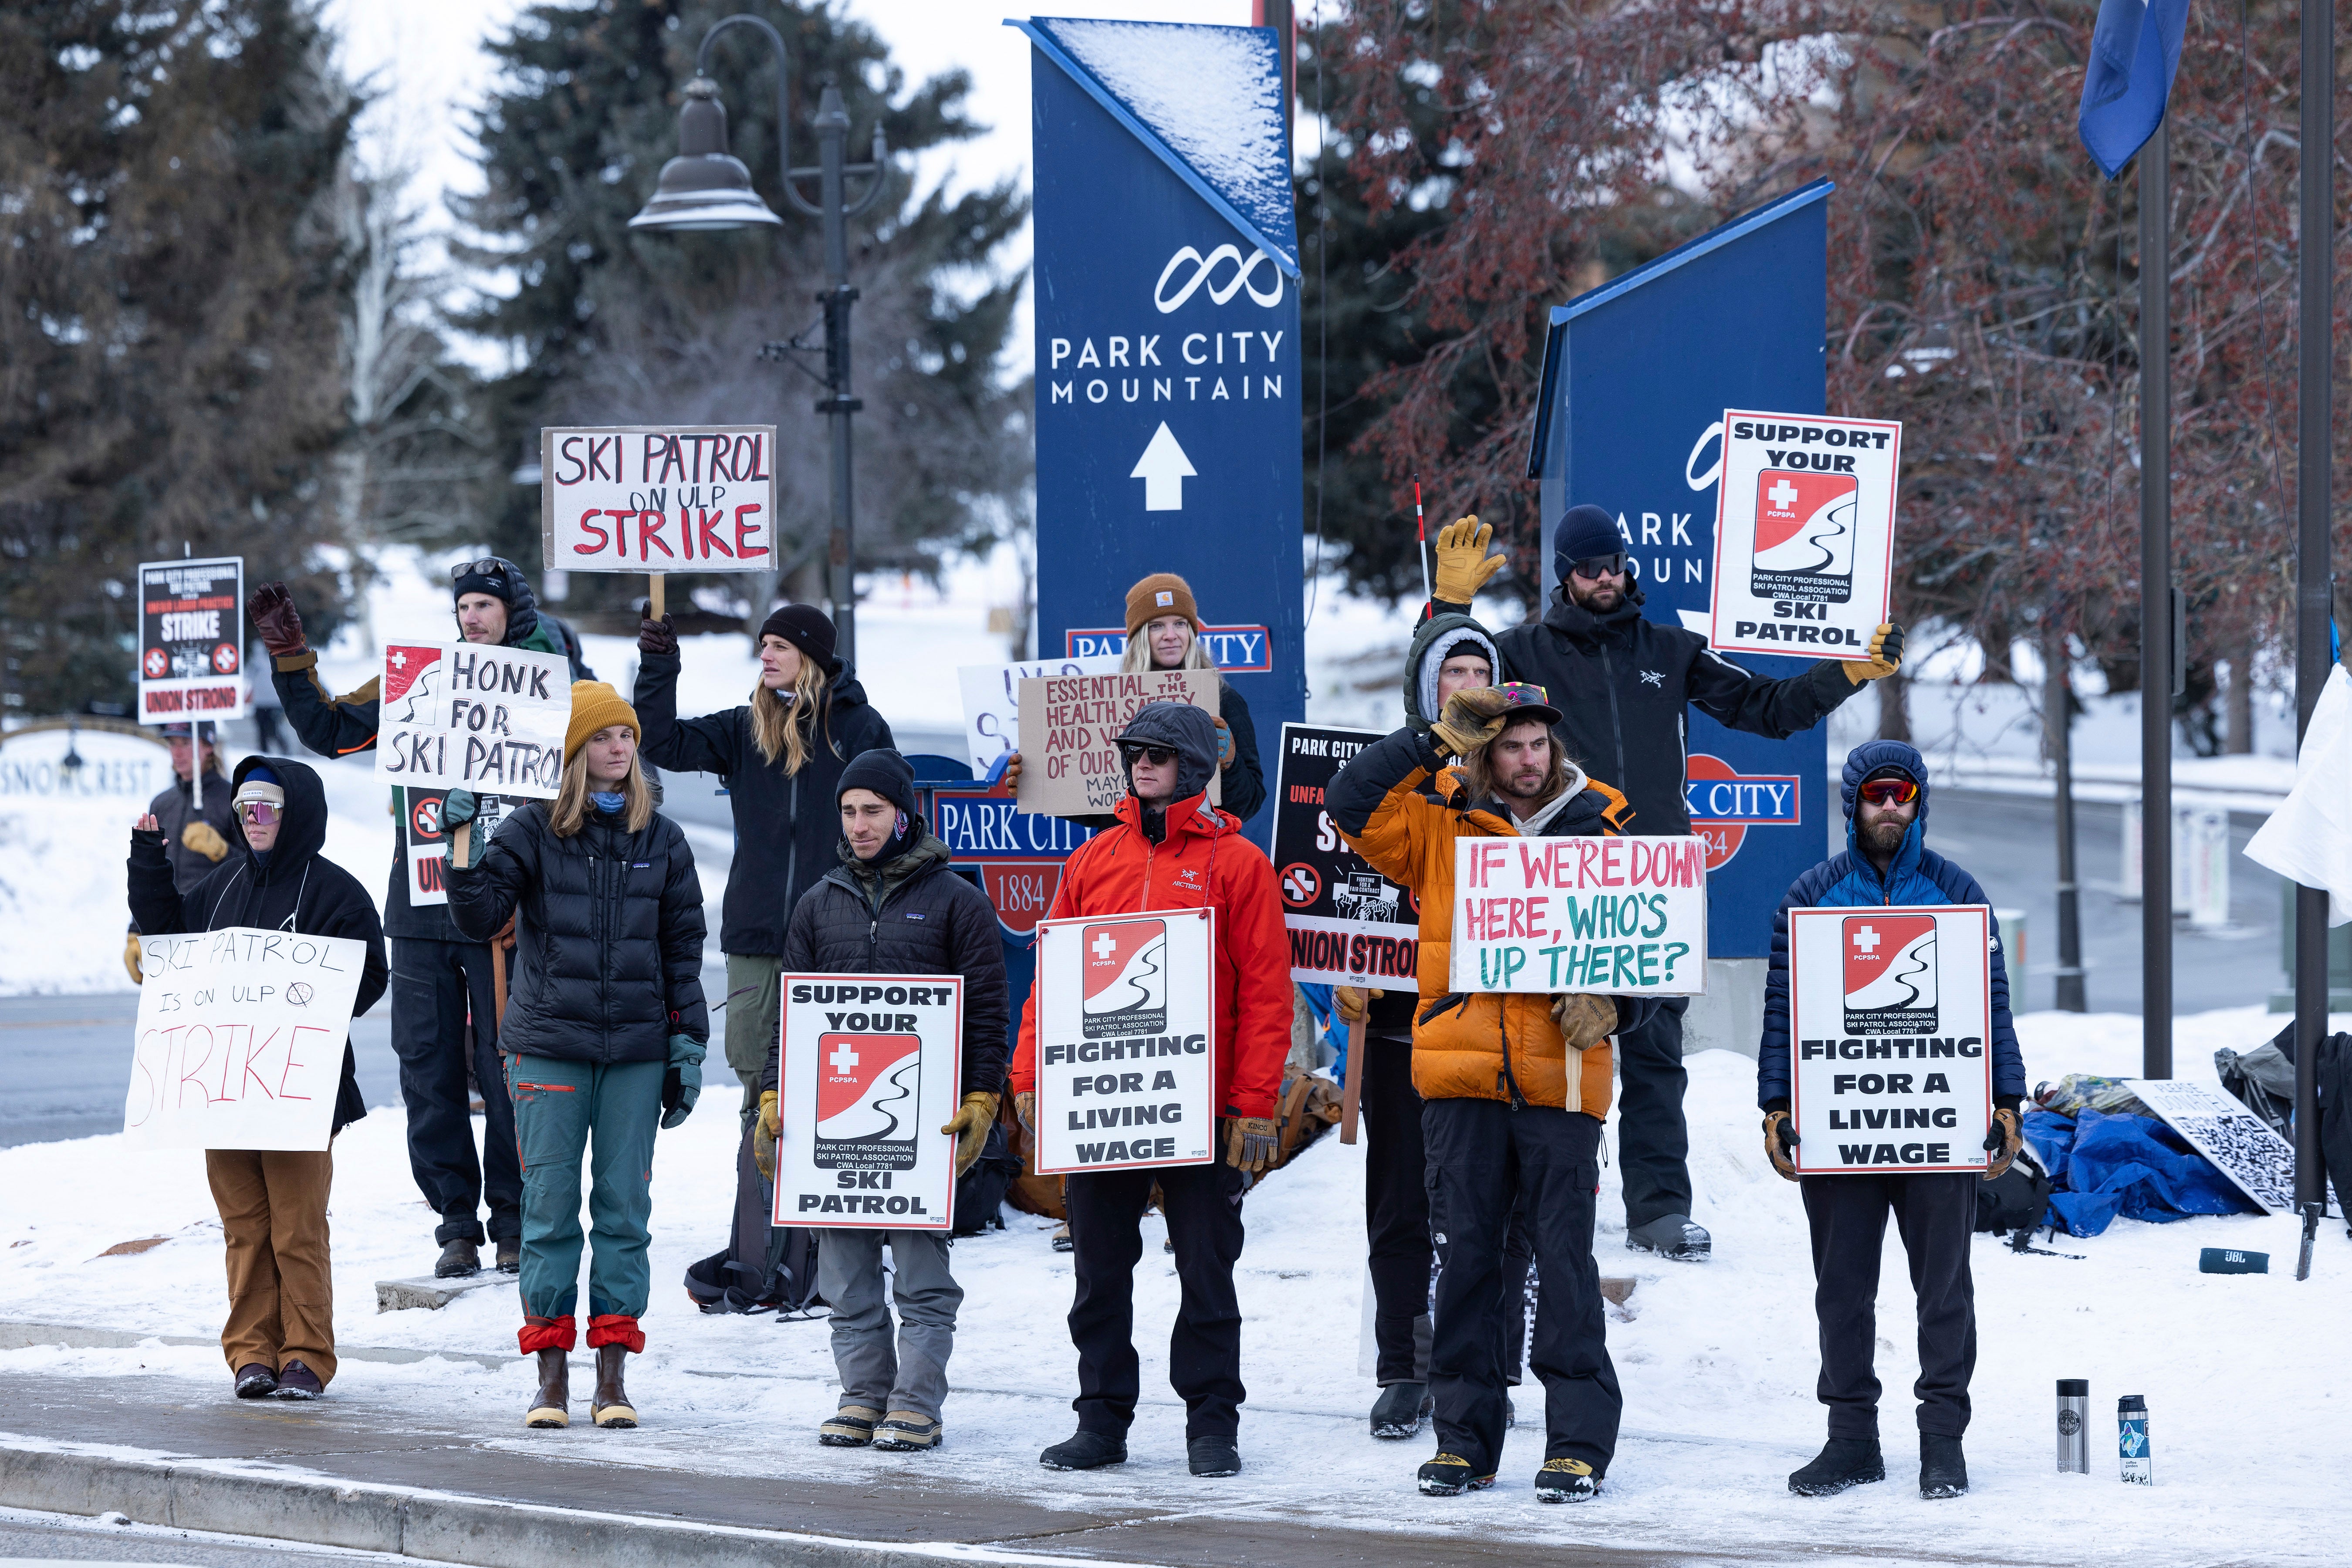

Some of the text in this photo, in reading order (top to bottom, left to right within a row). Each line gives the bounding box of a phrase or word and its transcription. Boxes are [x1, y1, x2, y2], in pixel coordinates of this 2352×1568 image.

[1051, 330, 1283, 370] PARK CITY
[1051, 375, 1281, 404] MOUNTAIN
[1734, 422, 1890, 449] SUPPORT
[555, 434, 769, 486] SKI PATROL
[1766, 449, 1856, 473] YOUR
[630, 486, 725, 512] ON ULP
[574, 504, 769, 561] STRIKE
[1617, 511, 1693, 546] ARK
[1767, 584, 1797, 592] PATROL
[1798, 586, 1848, 595] ASSOCIATION
[1794, 577, 1850, 587] PROFESSIONAL
[1774, 601, 1827, 620] SKI
[162, 610, 220, 642] STRIKE
[1735, 621, 1861, 646] PATROL
[1198, 634, 1262, 664] ITY
[452, 651, 551, 700] HONK
[1158, 681, 1187, 693] THE
[1165, 672, 1183, 682] TO
[146, 686, 236, 713] UNION STRONG
[1046, 676, 1149, 704] ESSENTIAL
[451, 698, 512, 736] FOR
[385, 731, 447, 775] SKI
[1046, 727, 1091, 753] AND
[1292, 737, 1363, 758] PARK CITY
[1048, 750, 1115, 779] OF OUR
[1290, 785, 1324, 805] UNFA
[1709, 784, 1791, 815] CITY
[941, 804, 1021, 850] PARK
[1469, 838, 1702, 889] IF WE'RE DOWN
[999, 875, 1045, 911] 1884
[1466, 892, 1668, 944] HERE, WHO'S
[147, 932, 344, 977] SKI PATROL
[1349, 933, 1419, 978] STRO
[1480, 942, 1690, 989] UP THERE?
[159, 985, 274, 1012] IS ON ULP
[792, 985, 952, 1006] SUPPORT
[825, 1012, 917, 1032] YOUR
[1118, 1013, 1165, 1021] PROFESSIONAL
[1588, 1000, 1604, 1021] KINCO
[1122, 1020, 1164, 1029] ASSOCIATION
[1045, 1034, 1206, 1065] FIGHTING
[1801, 1037, 1982, 1060] FIGHTING
[131, 1024, 330, 1127] STRIKE
[1073, 1070, 1176, 1097] FOR A
[1834, 1073, 1951, 1095] FOR A
[2154, 1083, 2203, 1093] PLEASE
[2154, 1094, 2235, 1112] DONATE!
[1068, 1103, 1182, 1131] LIVING
[1829, 1108, 1957, 1130] LIVING
[1076, 1137, 1175, 1163] WAGE
[1838, 1143, 1950, 1165] WAGE
[837, 1171, 892, 1189] SKI
[798, 1194, 927, 1215] PATROL
[2225, 1251, 2246, 1263] JBL
